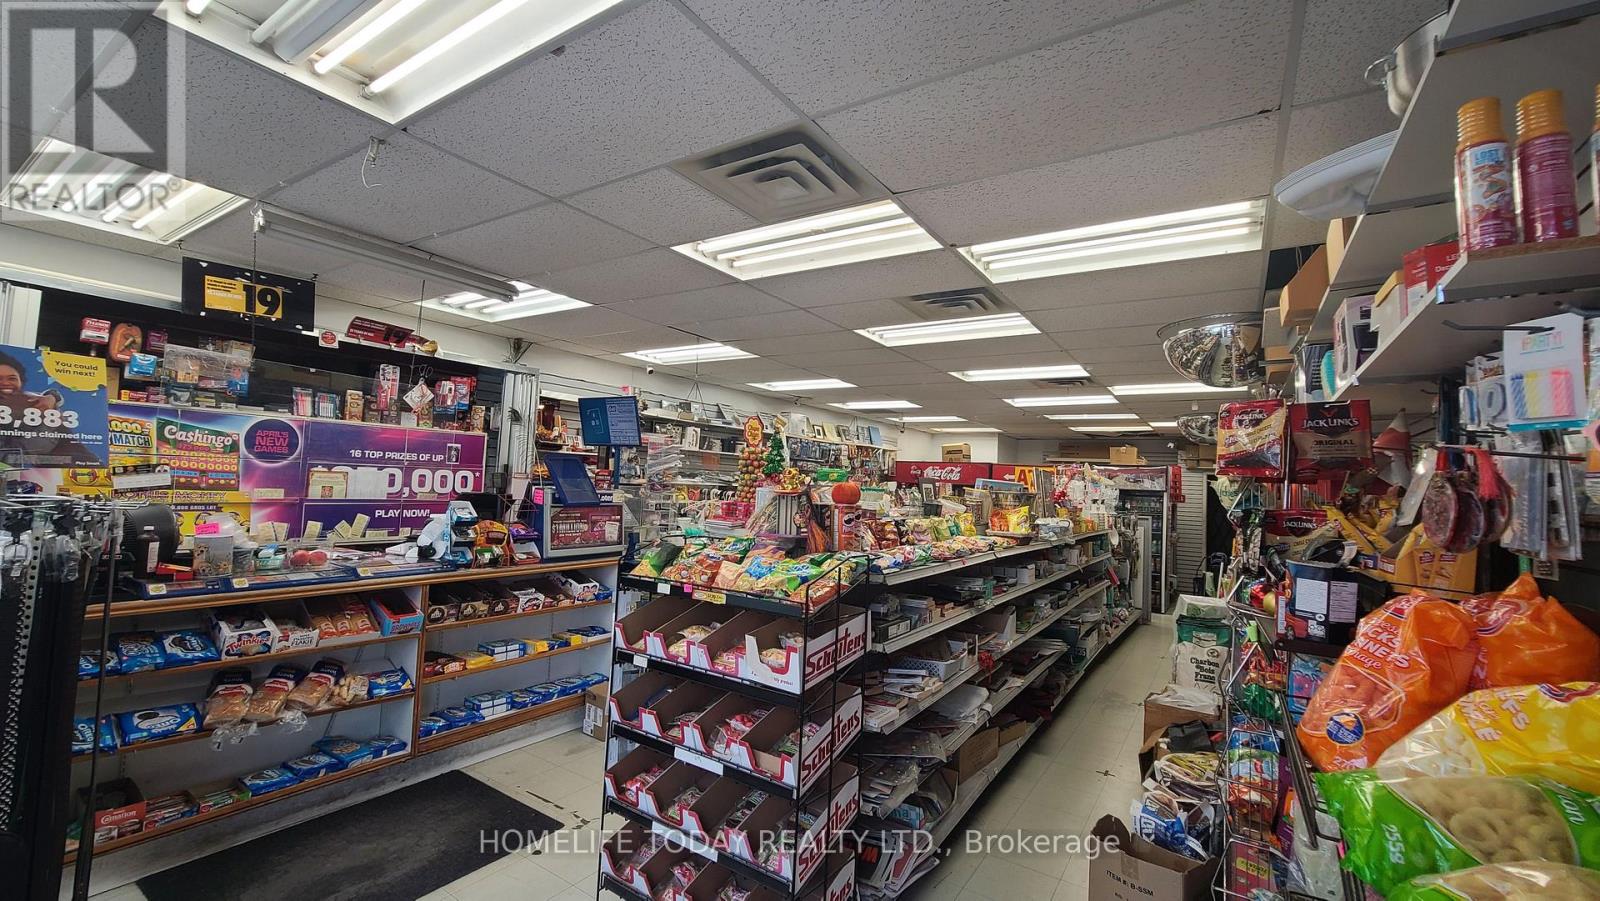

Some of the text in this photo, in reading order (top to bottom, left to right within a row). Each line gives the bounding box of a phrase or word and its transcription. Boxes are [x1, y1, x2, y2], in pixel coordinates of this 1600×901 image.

[242, 284, 281, 316] 19
[55, 360, 99, 371] You could
[55, 368, 71, 376] win
[1302, 418, 1329, 430] JACK
[39, 431, 80, 439] claimed
[164, 425, 233, 448] Cashingo
[256, 430, 288, 438] APRIL'S
[256, 437, 288, 447] NEW
[254, 445, 288, 453] GAMES
[350, 449, 362, 458] 16
[364, 450, 383, 459] TOP
[385, 451, 417, 461] PRIZES
[419, 453, 431, 461] OF
[375, 508, 430, 518] PLAY NOW!
[226, 634, 271, 653] Twinkies
[1190, 657, 1219, 668] Charbon
[1200, 666, 1215, 675] Bois
